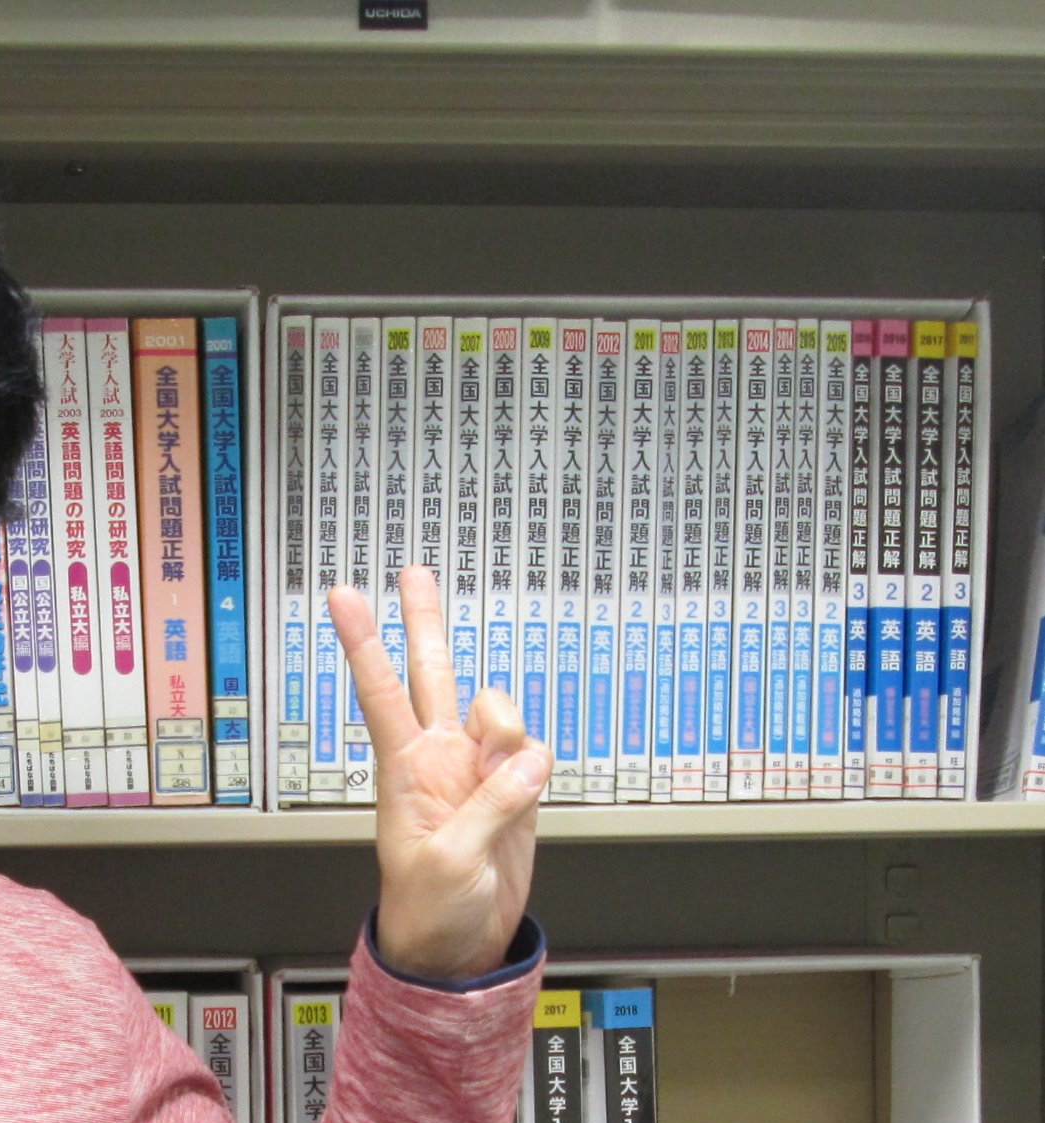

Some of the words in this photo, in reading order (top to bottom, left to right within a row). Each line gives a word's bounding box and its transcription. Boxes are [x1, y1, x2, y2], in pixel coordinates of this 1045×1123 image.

[365, 8, 422, 18] UCHIDA
[144, 335, 186, 348] 2001
[206, 340, 233, 351] 2001
[564, 331, 585, 350] 2010
[597, 333, 620, 353] 2012
[634, 331, 653, 349] 2011
[748, 330, 769, 351] 2014
[919, 334, 943, 346] 2017
[59, 333, 78, 405] 大学入試
[102, 333, 122, 405] 大学入試
[57, 408, 82, 419] 2003
[100, 408, 126, 419] 2003
[156, 365, 185, 582] 全国大学入試問題正解
[210, 364, 240, 582] 全国大学入試問題正解
[456, 357, 480, 596] 全国大学入試問題正解
[492, 353, 515, 591] 全国大学入試問題正解
[527, 353, 550, 592] 全国大学入試問題正解
[561, 354, 584, 592] 全国大学入試問題正解
[594, 357, 618, 595] 全国大学入試問題正解
[683, 354, 706, 593] 全国大学入試問題正解
[713, 353, 734, 591] 全国大学入試問題正解
[743, 354, 767, 593] 全国大学入試問題正解
[773, 352, 793, 591] 全国大学入試問題正解
[822, 356, 846, 594] 全国大学入試問題正解
[851, 363, 870, 569] 全国大学入試問題正解
[882, 364, 903, 569] 全国大学入試問題正解
[918, 365, 940, 570] 全国大学入試問題正解
[954, 364, 974, 569] 全国大学入試問題正解
[61, 421, 86, 559] 英語問題の研究
[104, 421, 130, 559] 英語問題の研究
[219, 596, 234, 611] 4
[459, 605, 470, 622] 2
[826, 602, 837, 620] 2
[921, 583, 933, 601] 2
[11, 576, 31, 657] 国公立大編
[34, 575, 54, 657] 国公立大編
[69, 585, 90, 652] 私立大編
[112, 585, 134, 652] 私立大編
[164, 619, 188, 662] 英語
[216, 621, 242, 664] 英語
[454, 630, 475, 677] 英語
[525, 626, 547, 673] 英語
[593, 630, 611, 675] 英語
[658, 630, 674, 677] 英語
[681, 626, 701, 672] 英語
[741, 627, 761, 673] 英語
[821, 628, 839, 673] 英語
[205, 1009, 235, 1029] 2012
[298, 1005, 328, 1025] 2013
[544, 1004, 567, 1016] 2017
[614, 1005, 638, 1016] 2018
